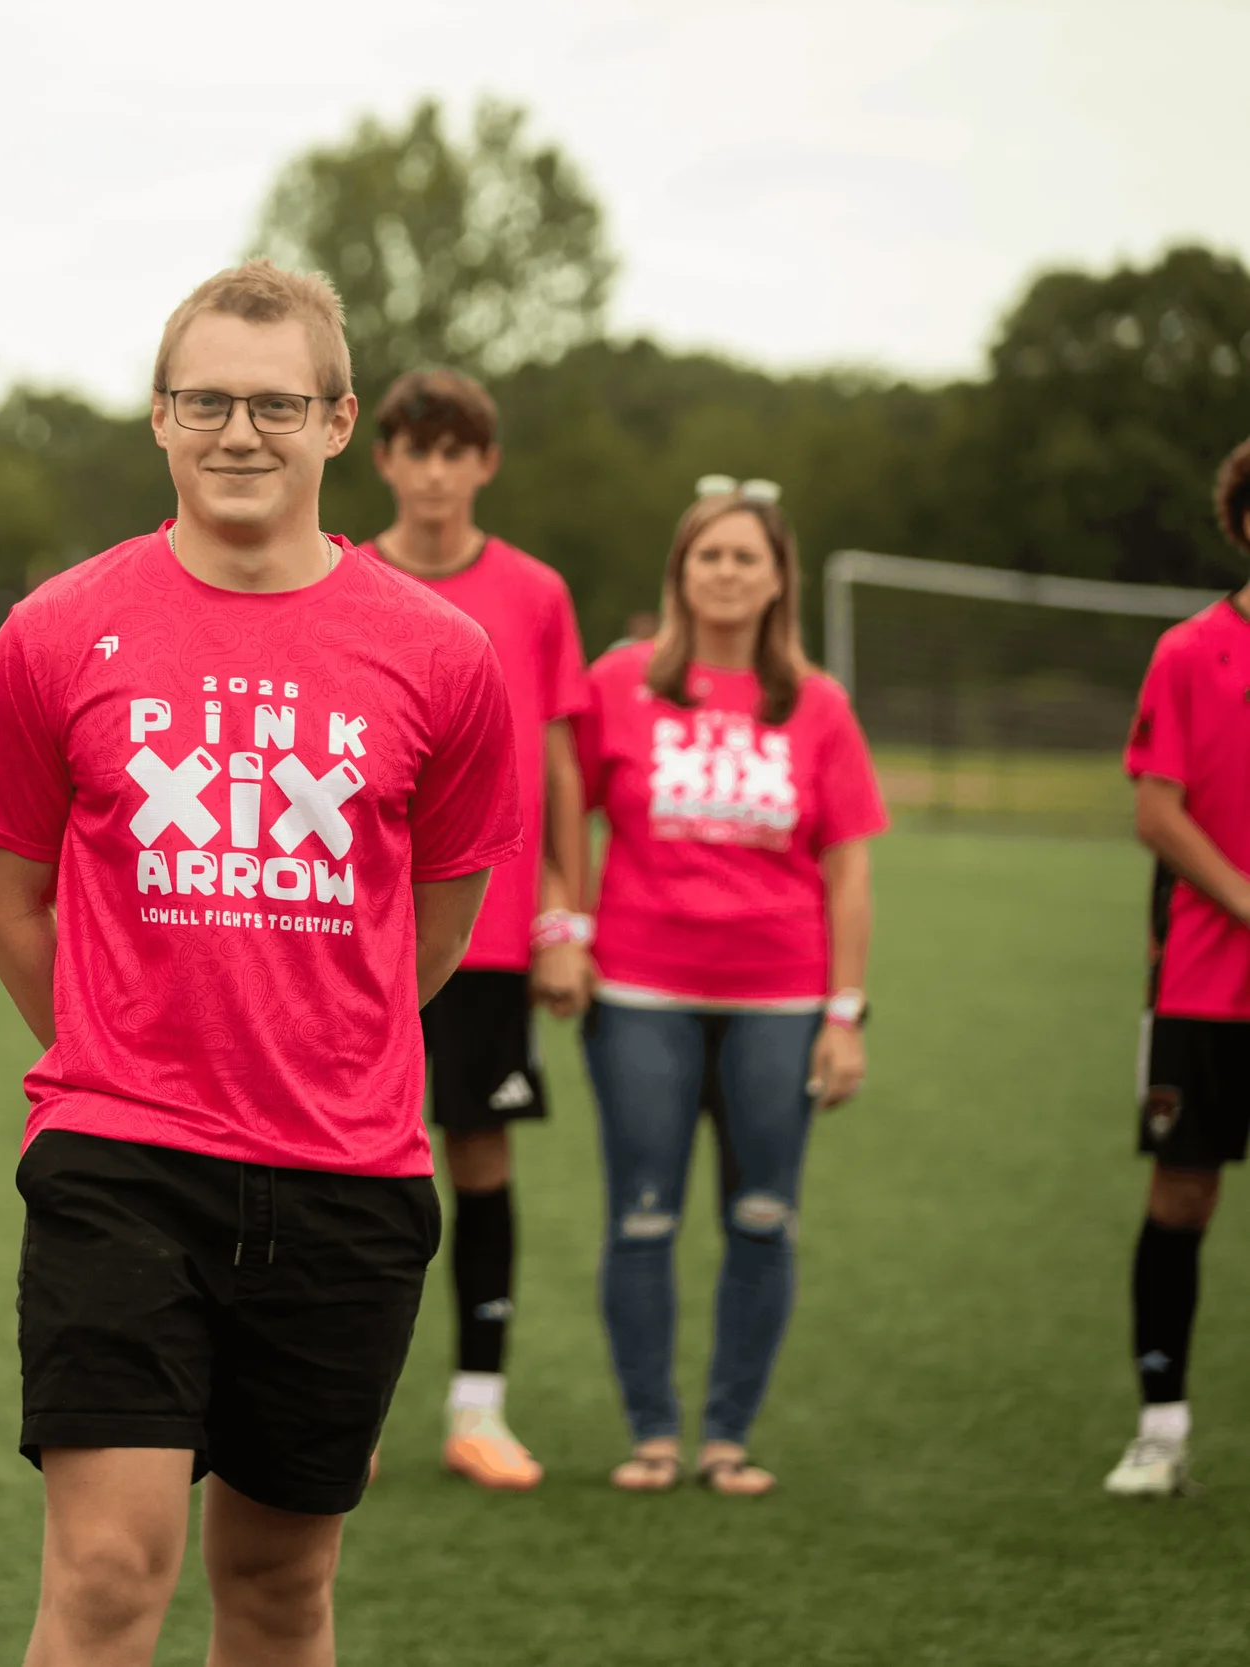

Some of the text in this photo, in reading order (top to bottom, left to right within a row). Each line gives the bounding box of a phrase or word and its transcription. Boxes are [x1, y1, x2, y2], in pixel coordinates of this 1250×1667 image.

[203, 675, 299, 698] 2026
[137, 849, 355, 906] ARROW
[141, 907, 199, 926] LOWELL
[268, 913, 354, 936] TOGETHER
